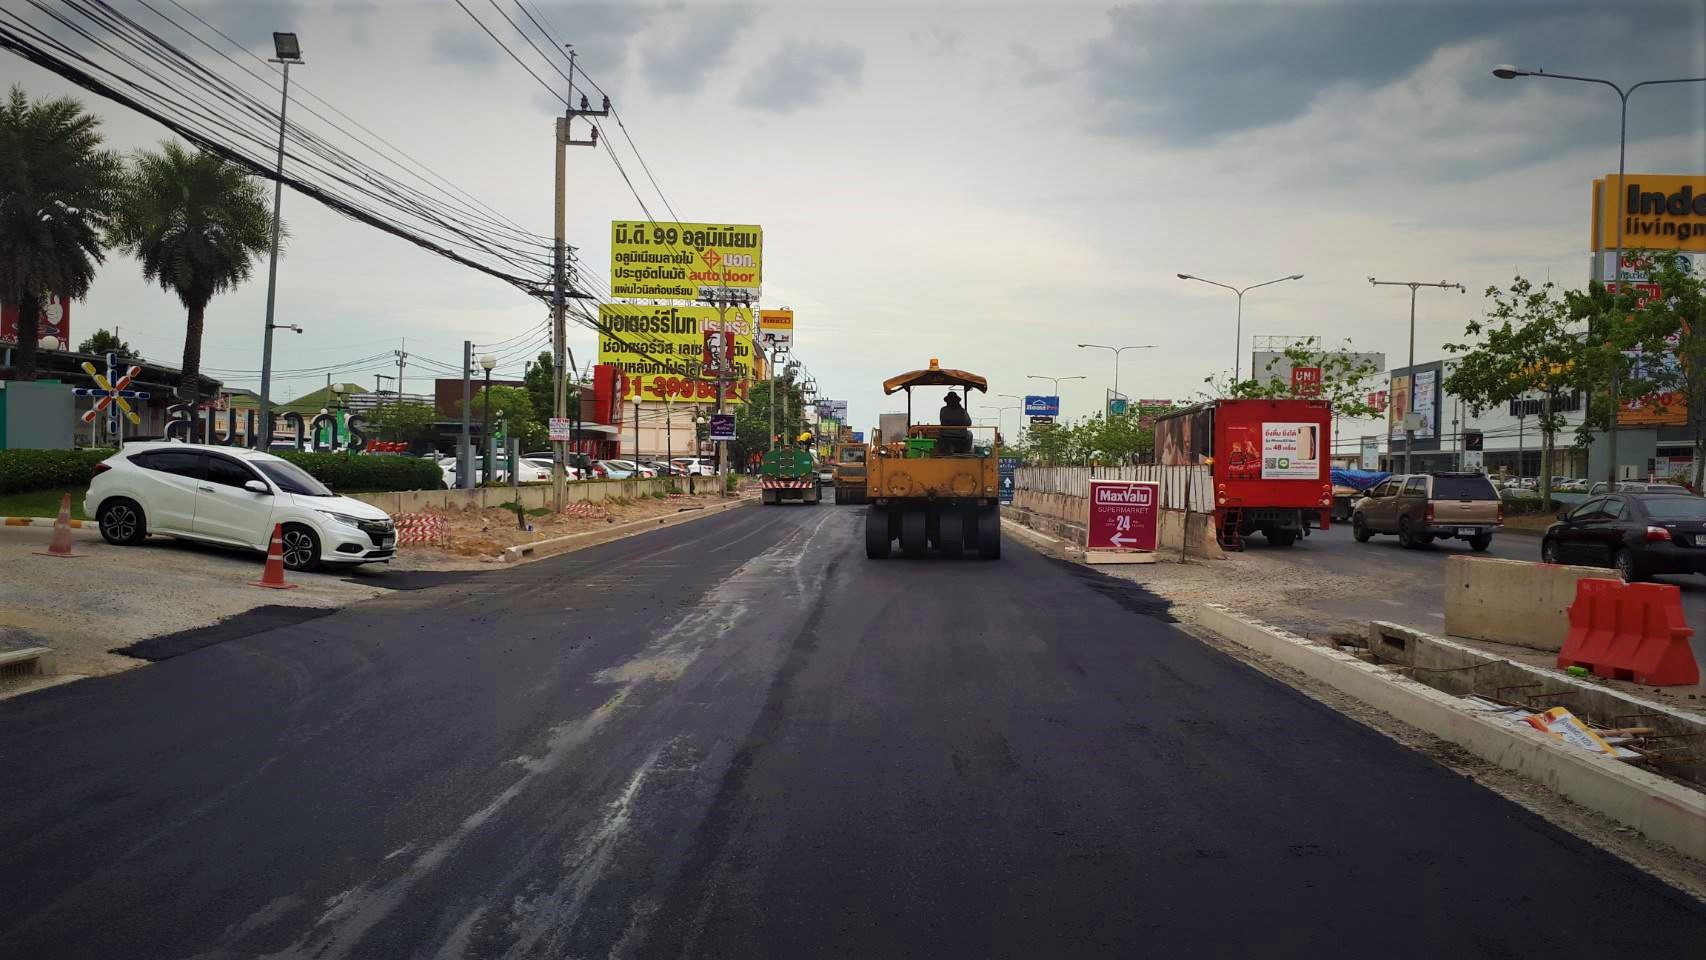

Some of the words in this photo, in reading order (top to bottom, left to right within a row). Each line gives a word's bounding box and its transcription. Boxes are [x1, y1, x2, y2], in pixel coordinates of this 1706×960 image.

[653, 228, 678, 245] 99
[683, 227, 757, 252] อลูมิเนียม
[615, 251, 694, 265] อลูมิเนียมลายไม้
[615, 266, 685, 282] ประตูอัตโนมัติ
[689, 270, 719, 281] auto
[723, 270, 755, 283] door
[1100, 490, 1148, 502] MaxValu
[1116, 515, 1130, 530] 24
